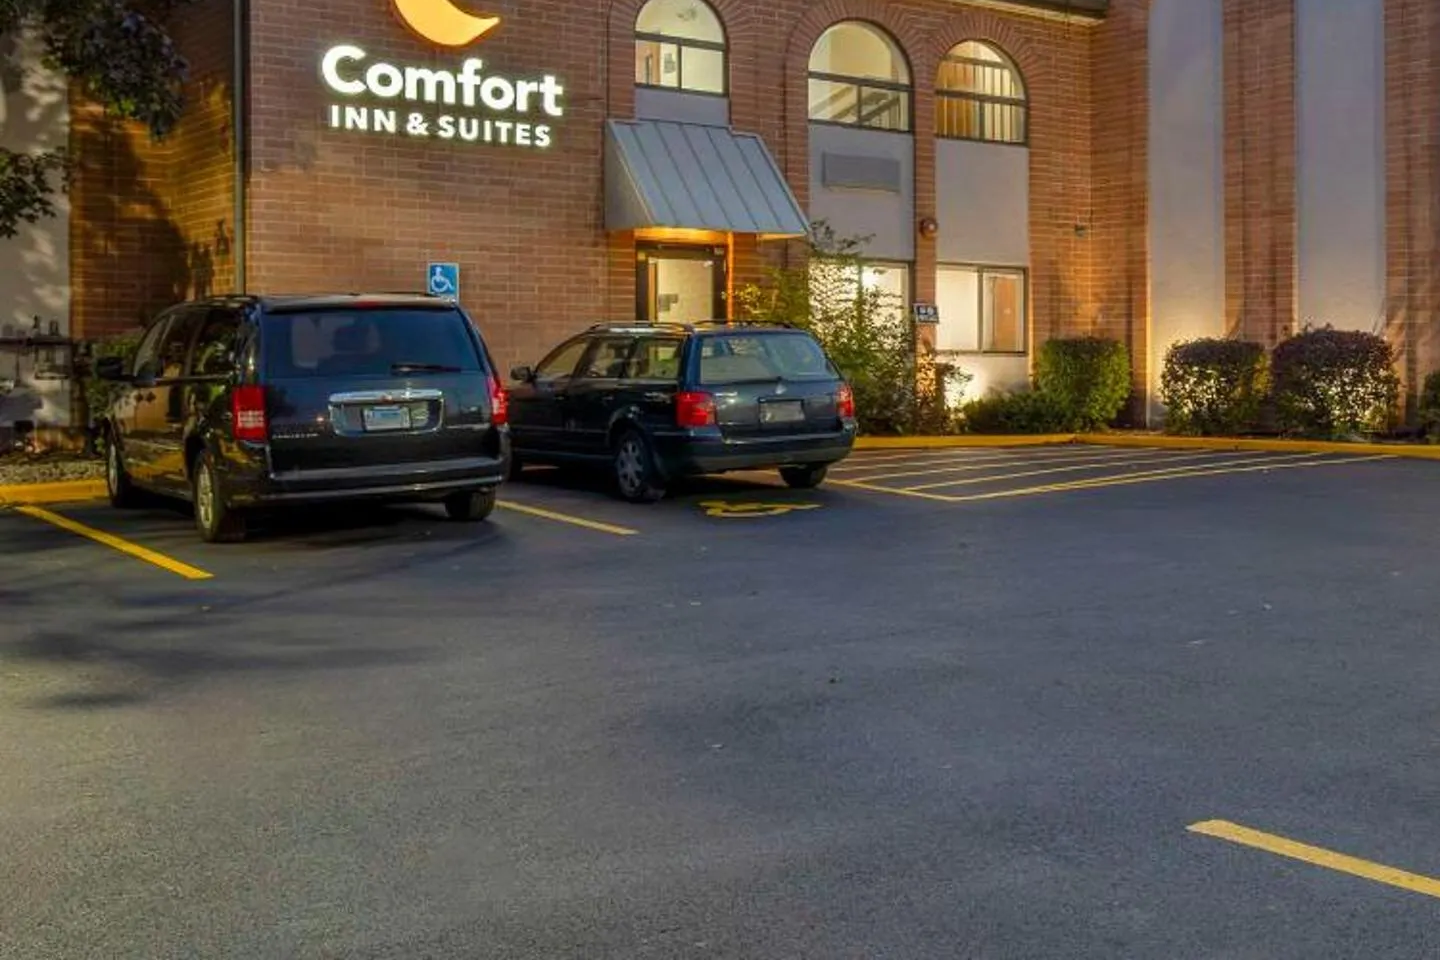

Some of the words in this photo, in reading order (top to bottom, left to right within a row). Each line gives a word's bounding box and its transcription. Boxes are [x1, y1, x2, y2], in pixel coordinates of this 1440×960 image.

[321, 44, 564, 117] Comfort
[331, 104, 397, 133] INN
[406, 112, 430, 136] &
[438, 115, 552, 147] SUITES
